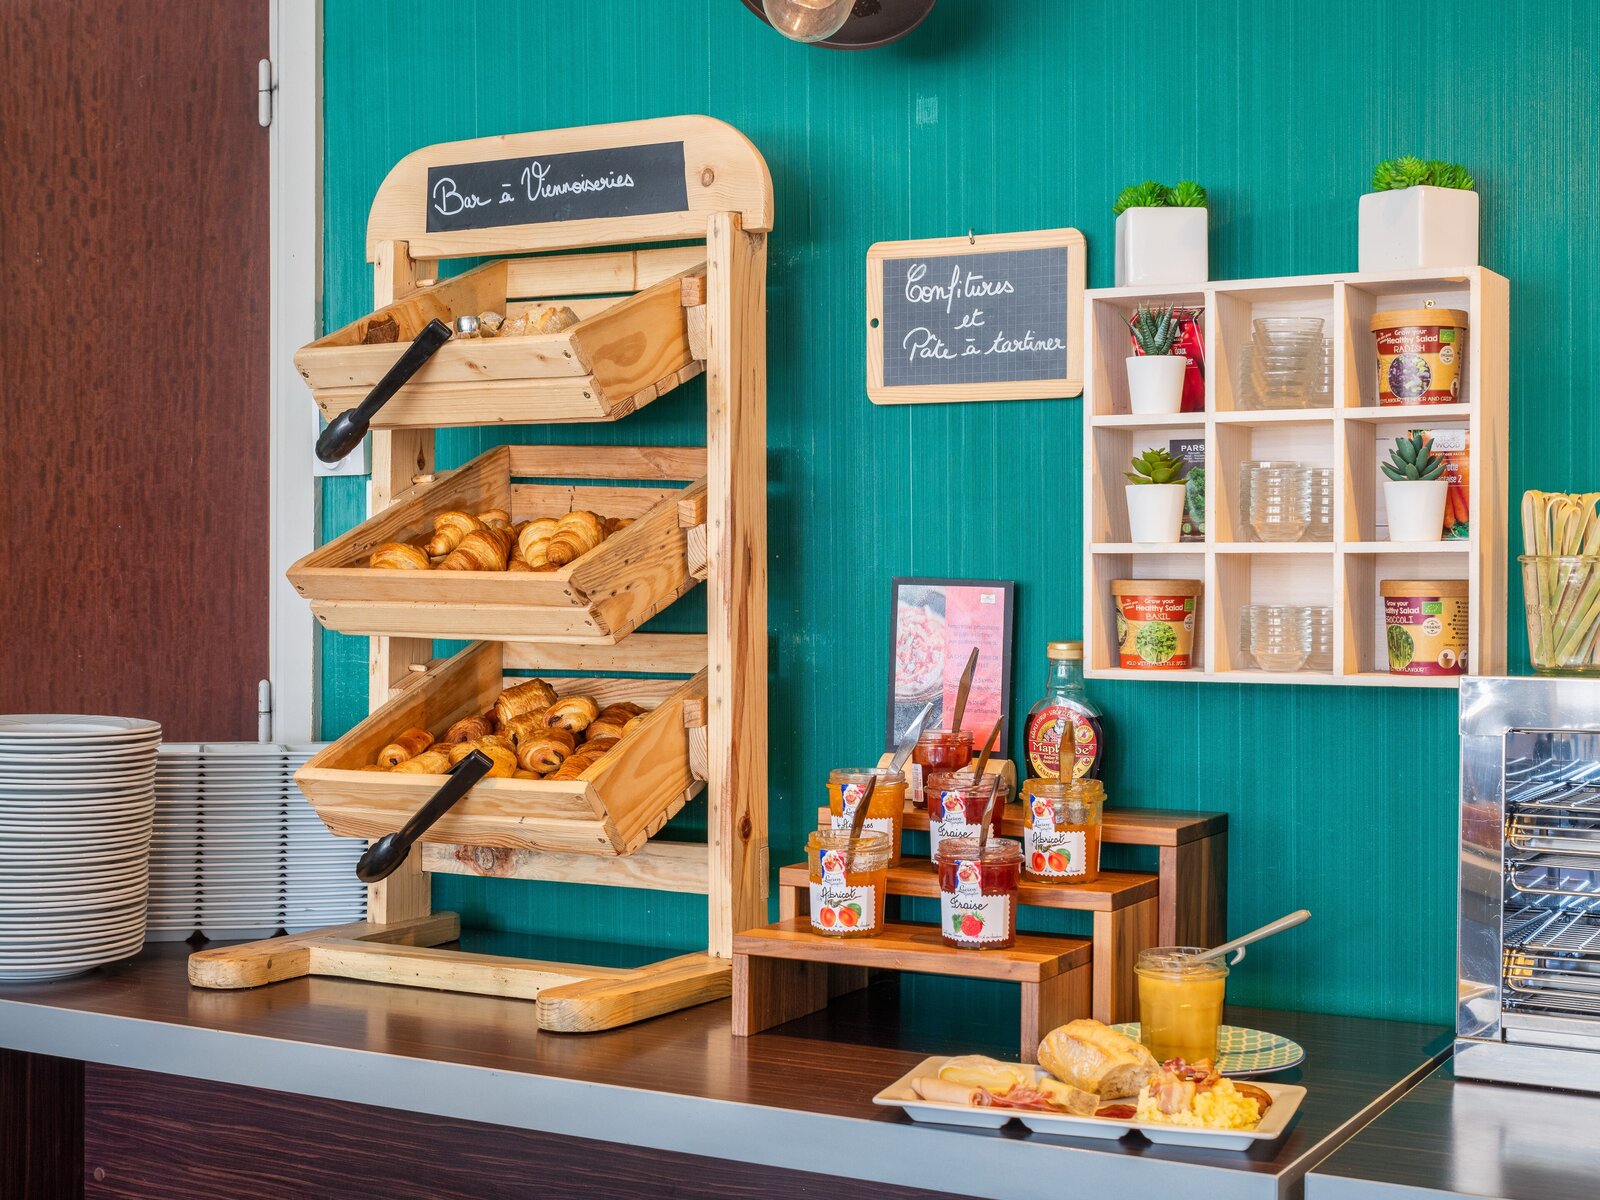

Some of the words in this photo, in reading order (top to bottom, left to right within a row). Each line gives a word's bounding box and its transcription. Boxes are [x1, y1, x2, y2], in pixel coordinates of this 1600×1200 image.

[433, 177, 491, 215] Bar
[521, 161, 634, 201] Viennoiseries
[905, 264, 1014, 314] Confitures
[954, 309, 985, 329] et
[903, 327, 957, 361] Pâte
[984, 331, 1066, 355] tartiner
[1386, 336, 1414, 345] Healthy
[1415, 335, 1438, 343] Salad
[1393, 344, 1425, 353] RADISH
[1457, 475, 1463, 483] 2
[1135, 604, 1163, 612] Healthy
[1145, 612, 1171, 620] BASIL
[1033, 741, 1060, 755] Mapl
[938, 822, 973, 838] Fraise
[1032, 831, 1066, 846] Abricot
[820, 886, 857, 899] Abricot
[950, 894, 989, 910] Fraise
